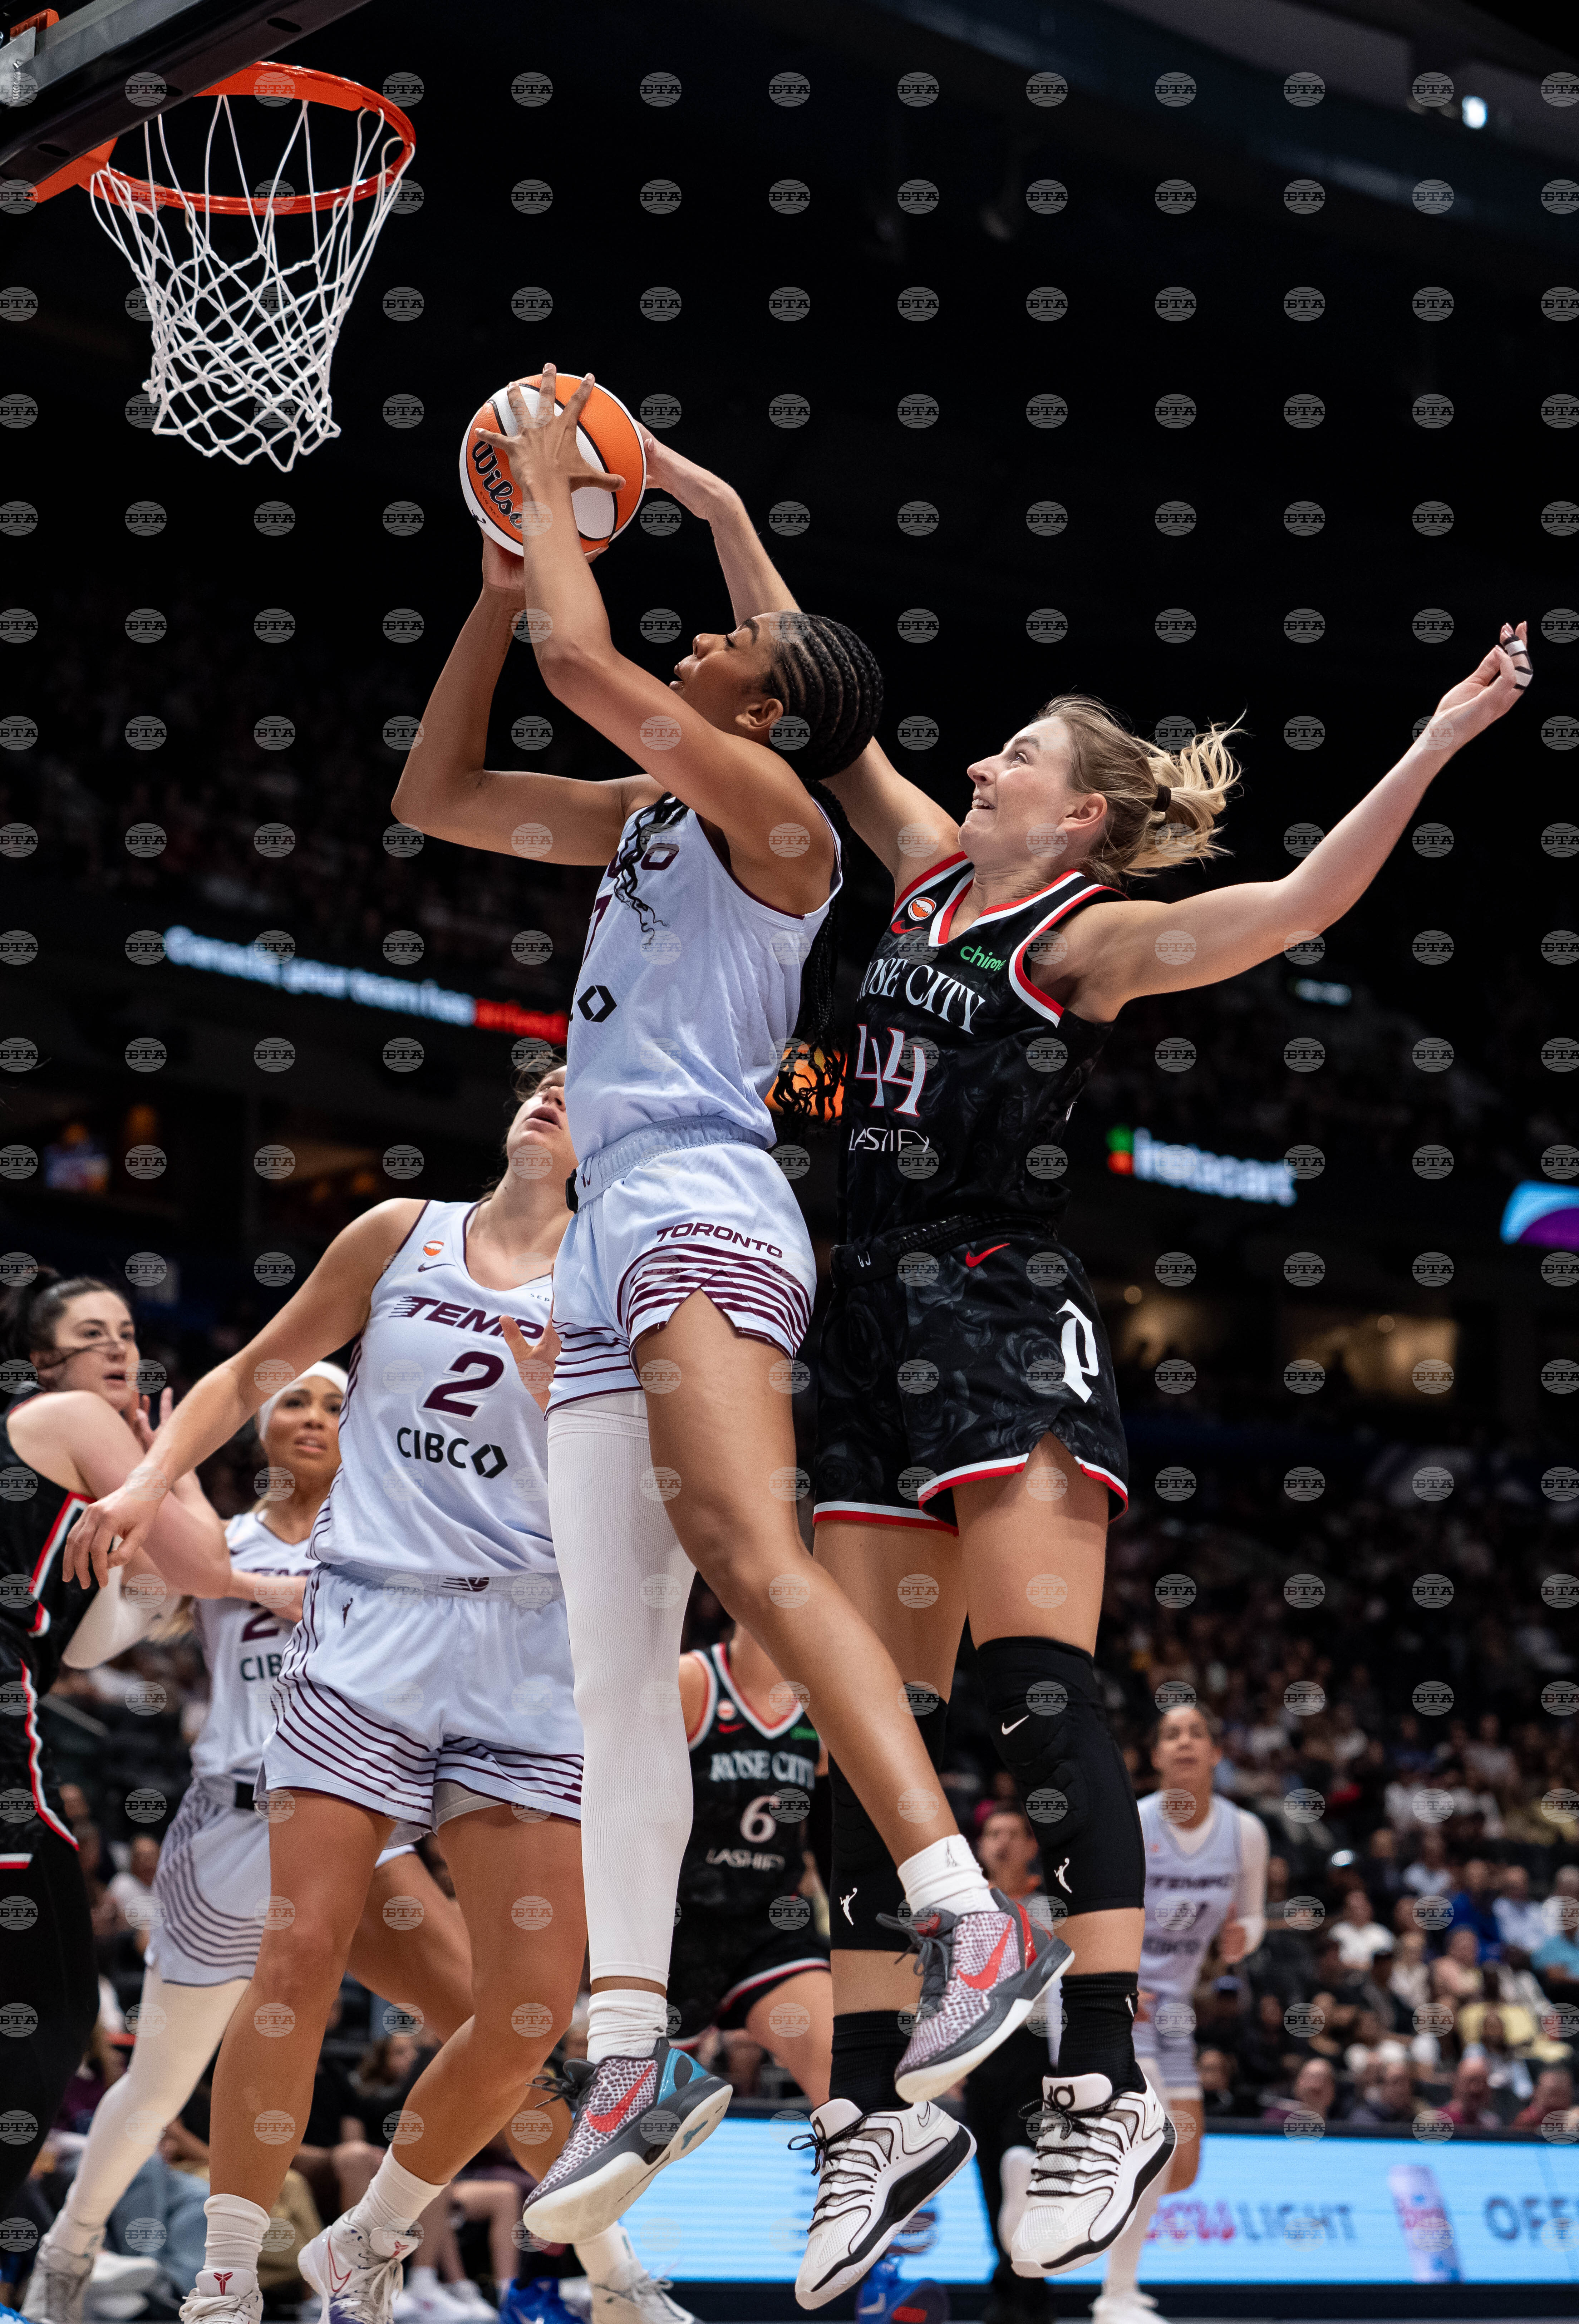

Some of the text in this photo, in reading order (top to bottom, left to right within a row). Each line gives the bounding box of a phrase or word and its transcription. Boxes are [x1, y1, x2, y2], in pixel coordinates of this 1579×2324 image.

[960, 946, 1007, 971] chime
[857, 958, 986, 1035] OSE CITY
[855, 1024, 926, 1117] 44
[657, 1223, 782, 1259] TORONTO
[420, 1349, 506, 1420] 2
[397, 1427, 469, 1469] CIBC
[740, 1795, 779, 1843] 6
